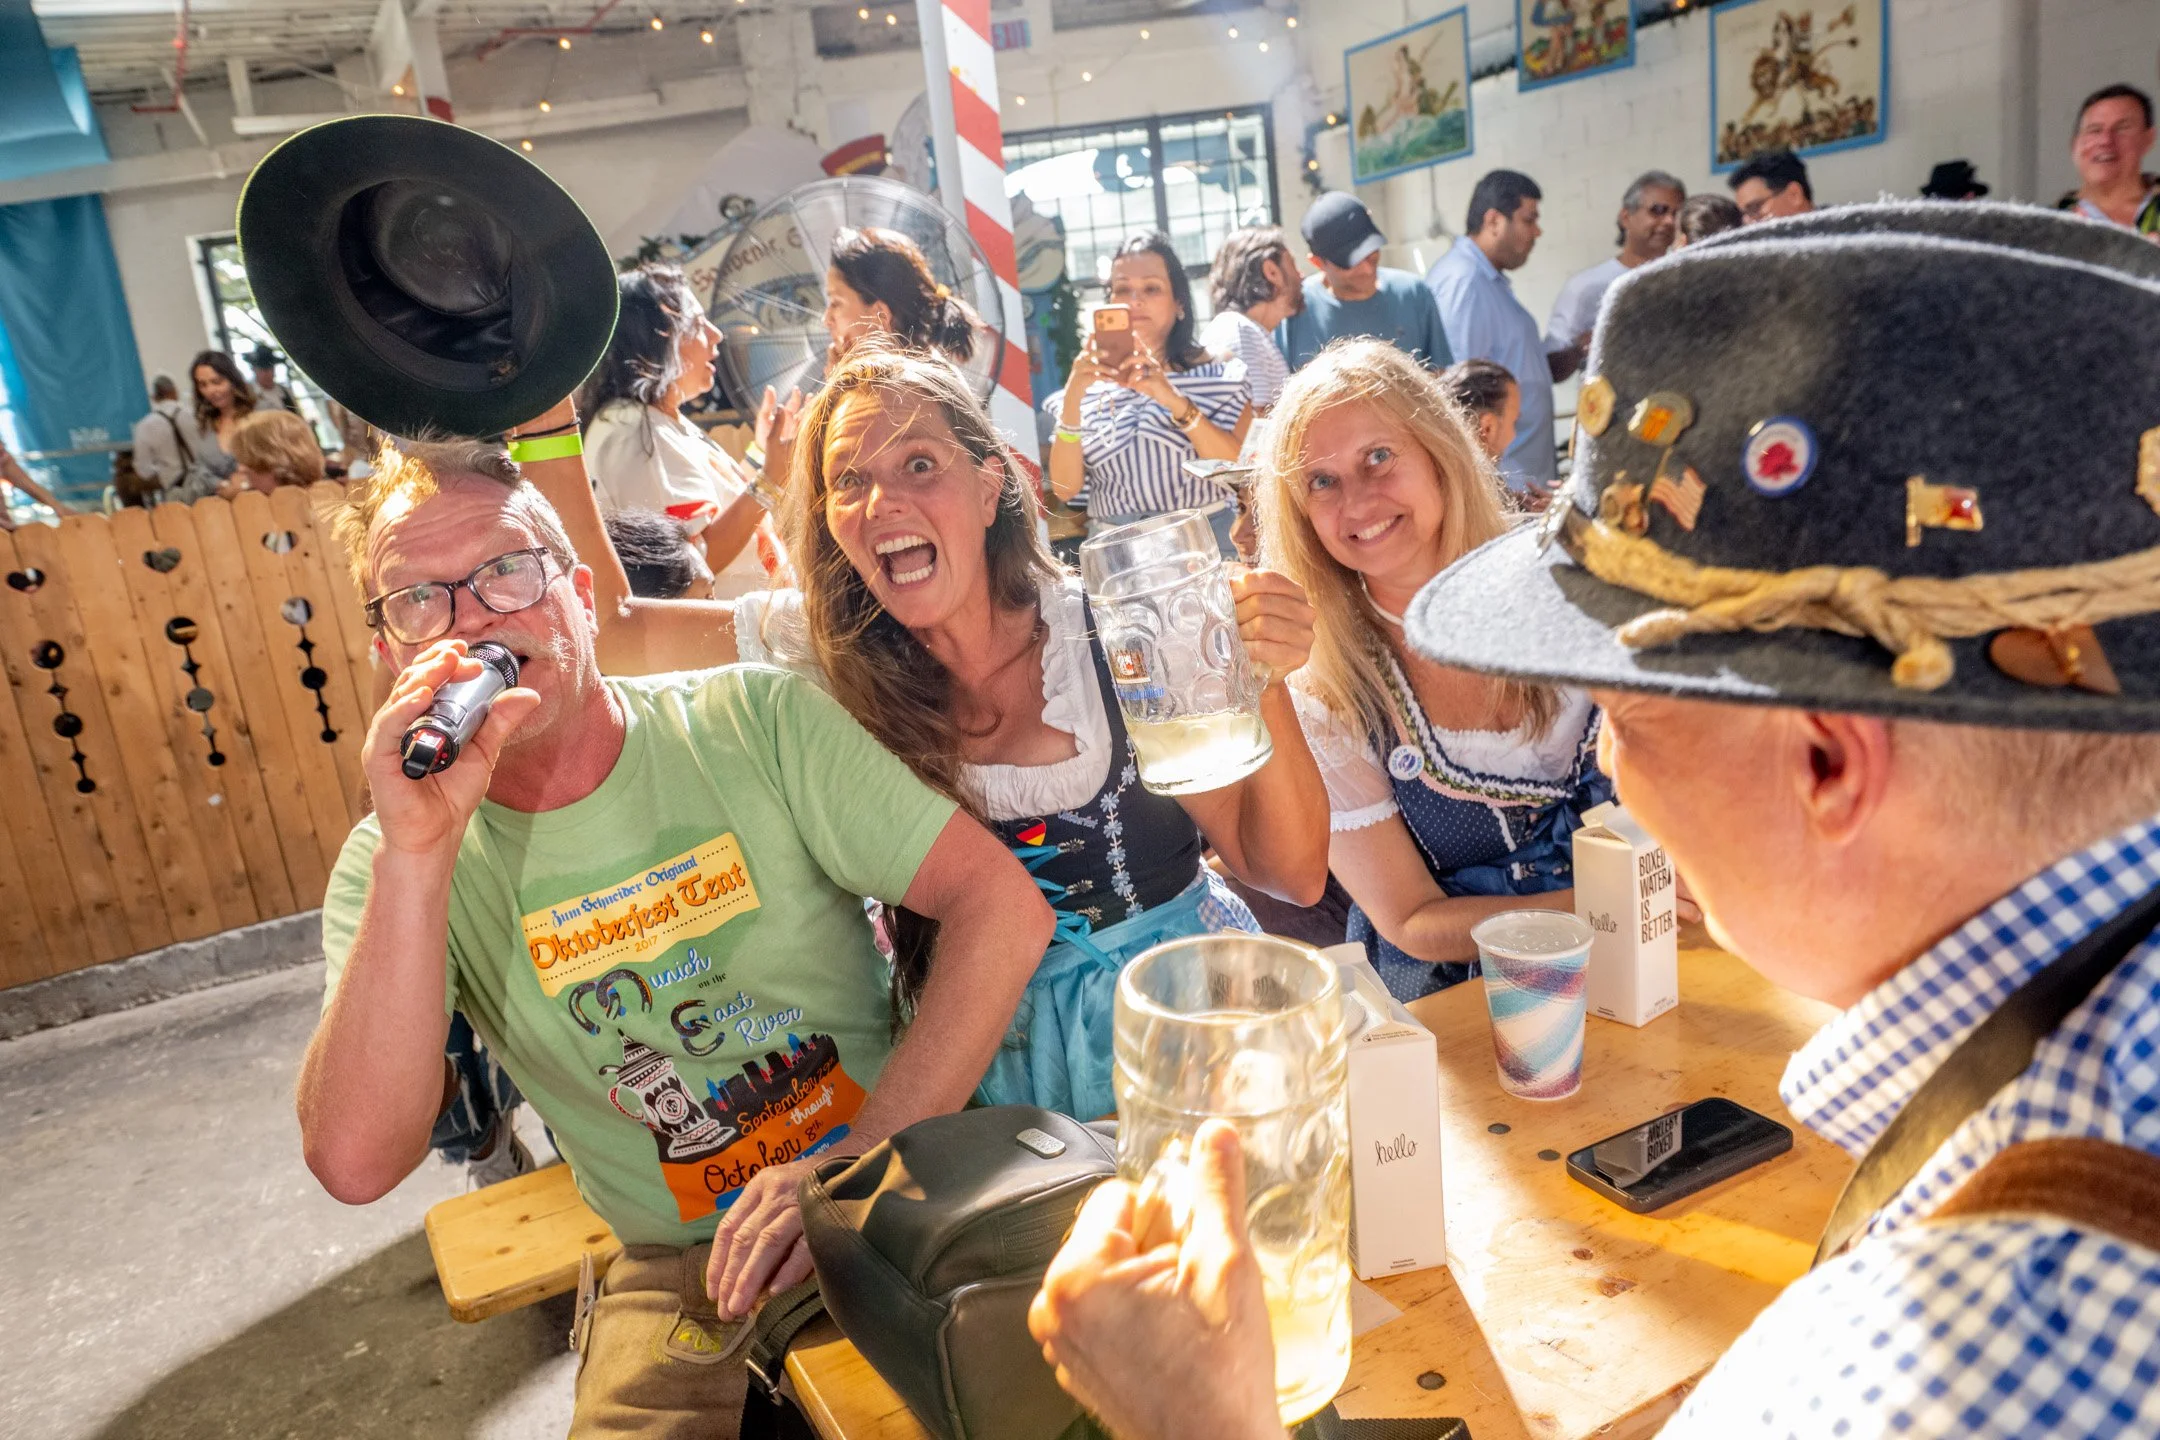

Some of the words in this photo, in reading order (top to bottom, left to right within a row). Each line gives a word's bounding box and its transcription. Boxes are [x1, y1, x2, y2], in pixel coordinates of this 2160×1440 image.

[1638, 845, 1666, 876] BOXED
[551, 908, 582, 928] Zum
[581, 882, 642, 912] Schneider
[645, 855, 697, 887] Original
[1639, 868, 1669, 899] WATER
[530, 891, 680, 970] Oktoberfest
[677, 861, 746, 907] Tent
[1588, 910, 1618, 934] hello
[1640, 900, 1650, 921] IS
[634, 935, 658, 953] 2017
[698, 978, 710, 989] on
[711, 972, 727, 984] the
[670, 991, 756, 1057] East
[734, 1006, 804, 1048] River
[736, 1077, 818, 1136] September
[789, 1084, 834, 1125] through
[703, 1138, 802, 1194] October
[1374, 1133, 1418, 1167] hello
